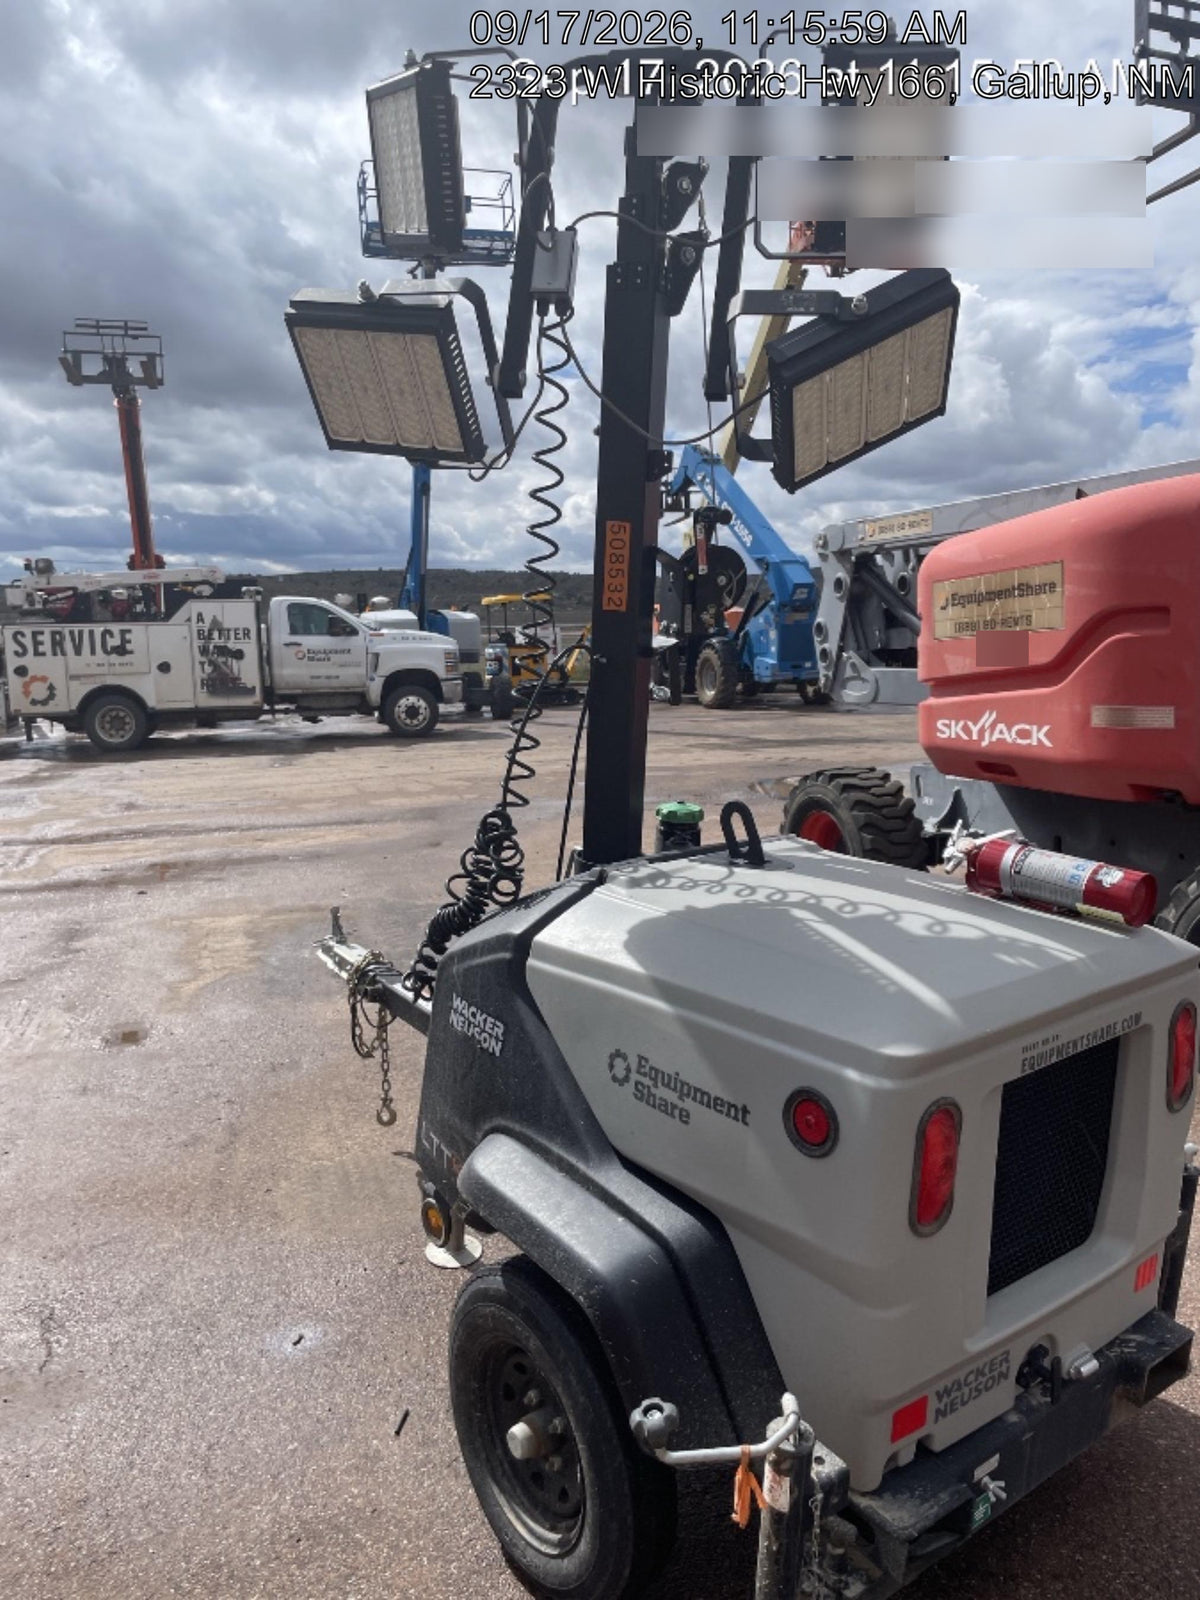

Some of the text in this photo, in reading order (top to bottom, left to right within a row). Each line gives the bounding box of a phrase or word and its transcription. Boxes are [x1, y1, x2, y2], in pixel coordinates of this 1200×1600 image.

[607, 523, 627, 608] 508532
[951, 581, 1057, 609] EquipmentShare
[11, 628, 134, 658] SERVICE
[196, 626, 252, 641] BETTER
[936, 710, 1053, 748] SKYJACK
[452, 992, 504, 1040] WACKER
[632, 1080, 691, 1125] Share
[636, 1053, 751, 1127] Equipment
[934, 1365, 1011, 1426] NEUSON
[935, 1349, 1011, 1405] WACKER
